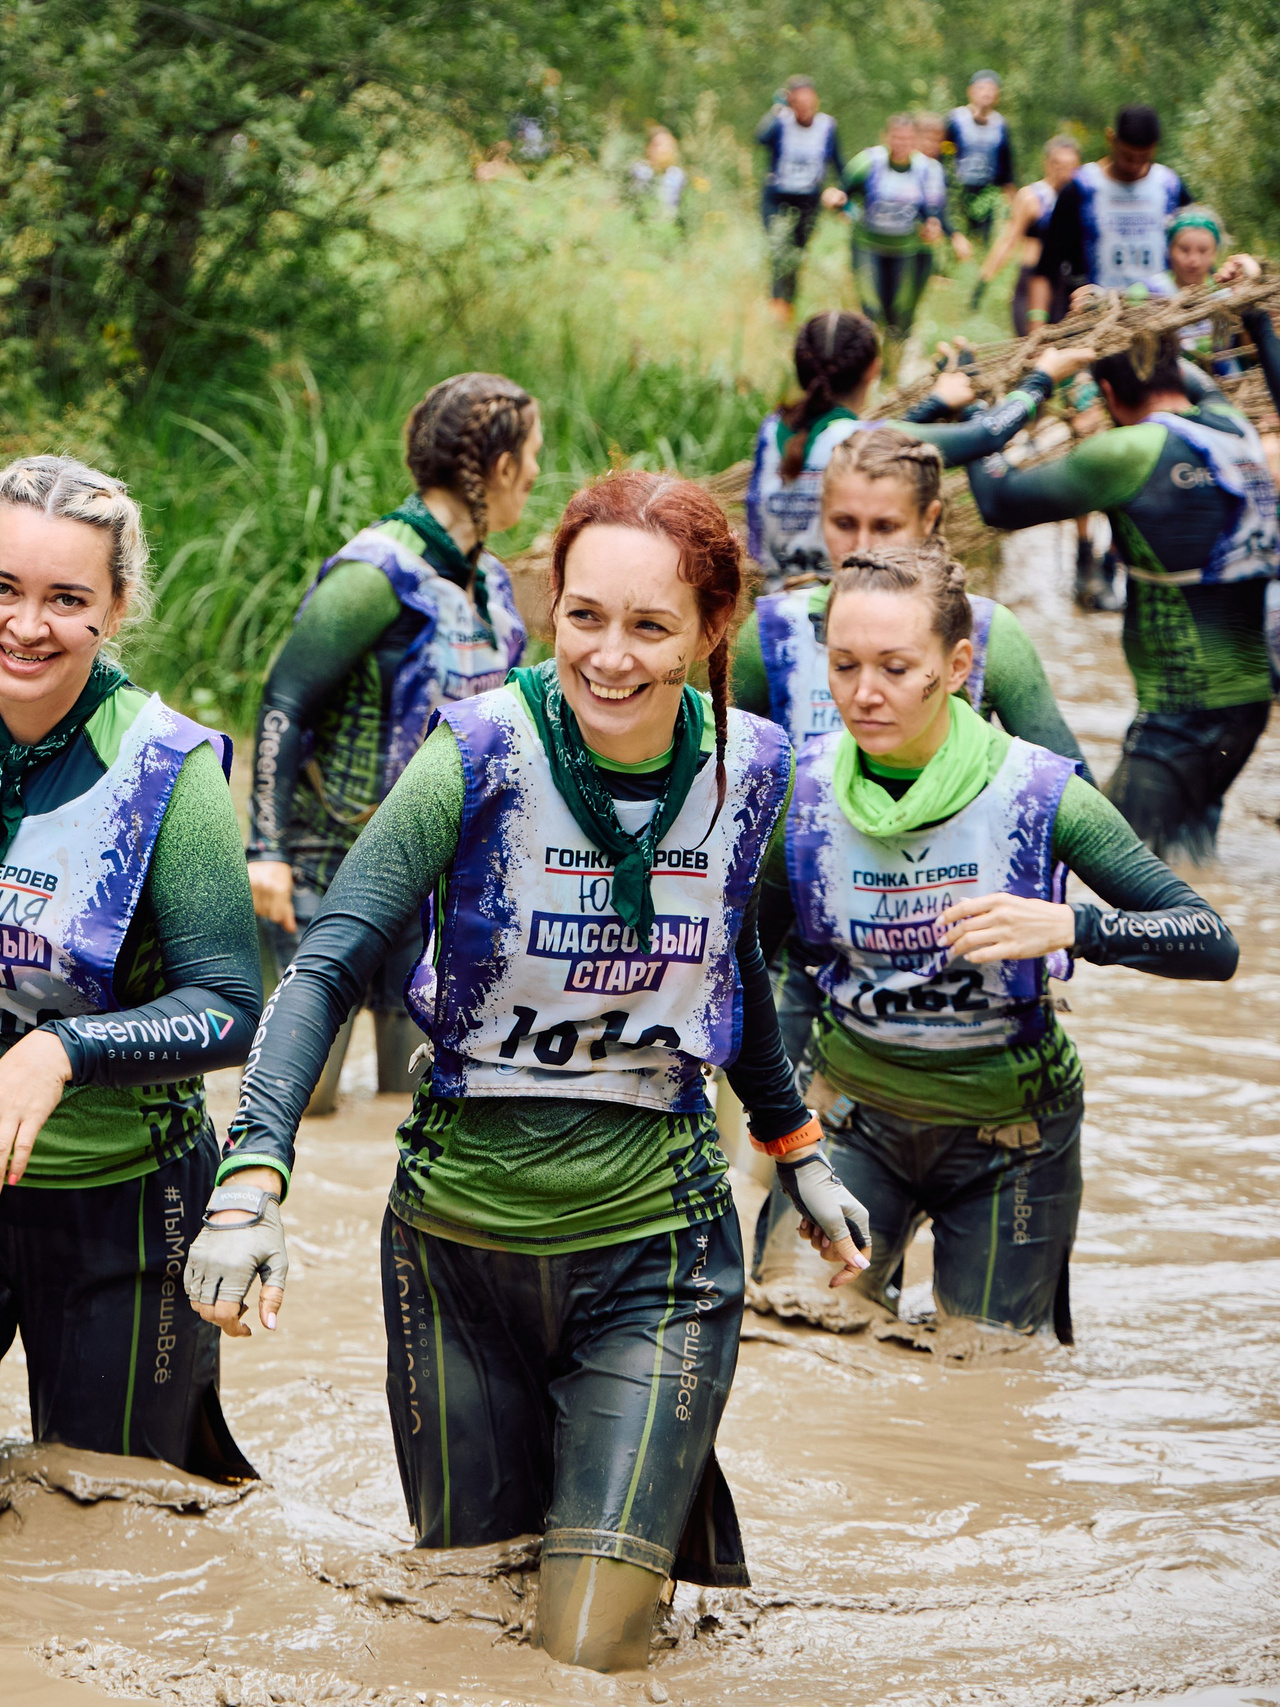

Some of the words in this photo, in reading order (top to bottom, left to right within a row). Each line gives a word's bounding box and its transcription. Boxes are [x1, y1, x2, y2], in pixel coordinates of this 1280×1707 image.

[652, 850, 709, 870] РОЕВ
[853, 870, 909, 887] ГОНКА
[914, 863, 979, 884] ГЕРОЕВ
[870, 892, 953, 922] ДИАНА
[571, 960, 663, 992] СТАРТ
[69, 1012, 211, 1049] Geenway
[108, 1050, 181, 1061] GLOBAL
[418, 1293, 431, 1378] GLOBAL
